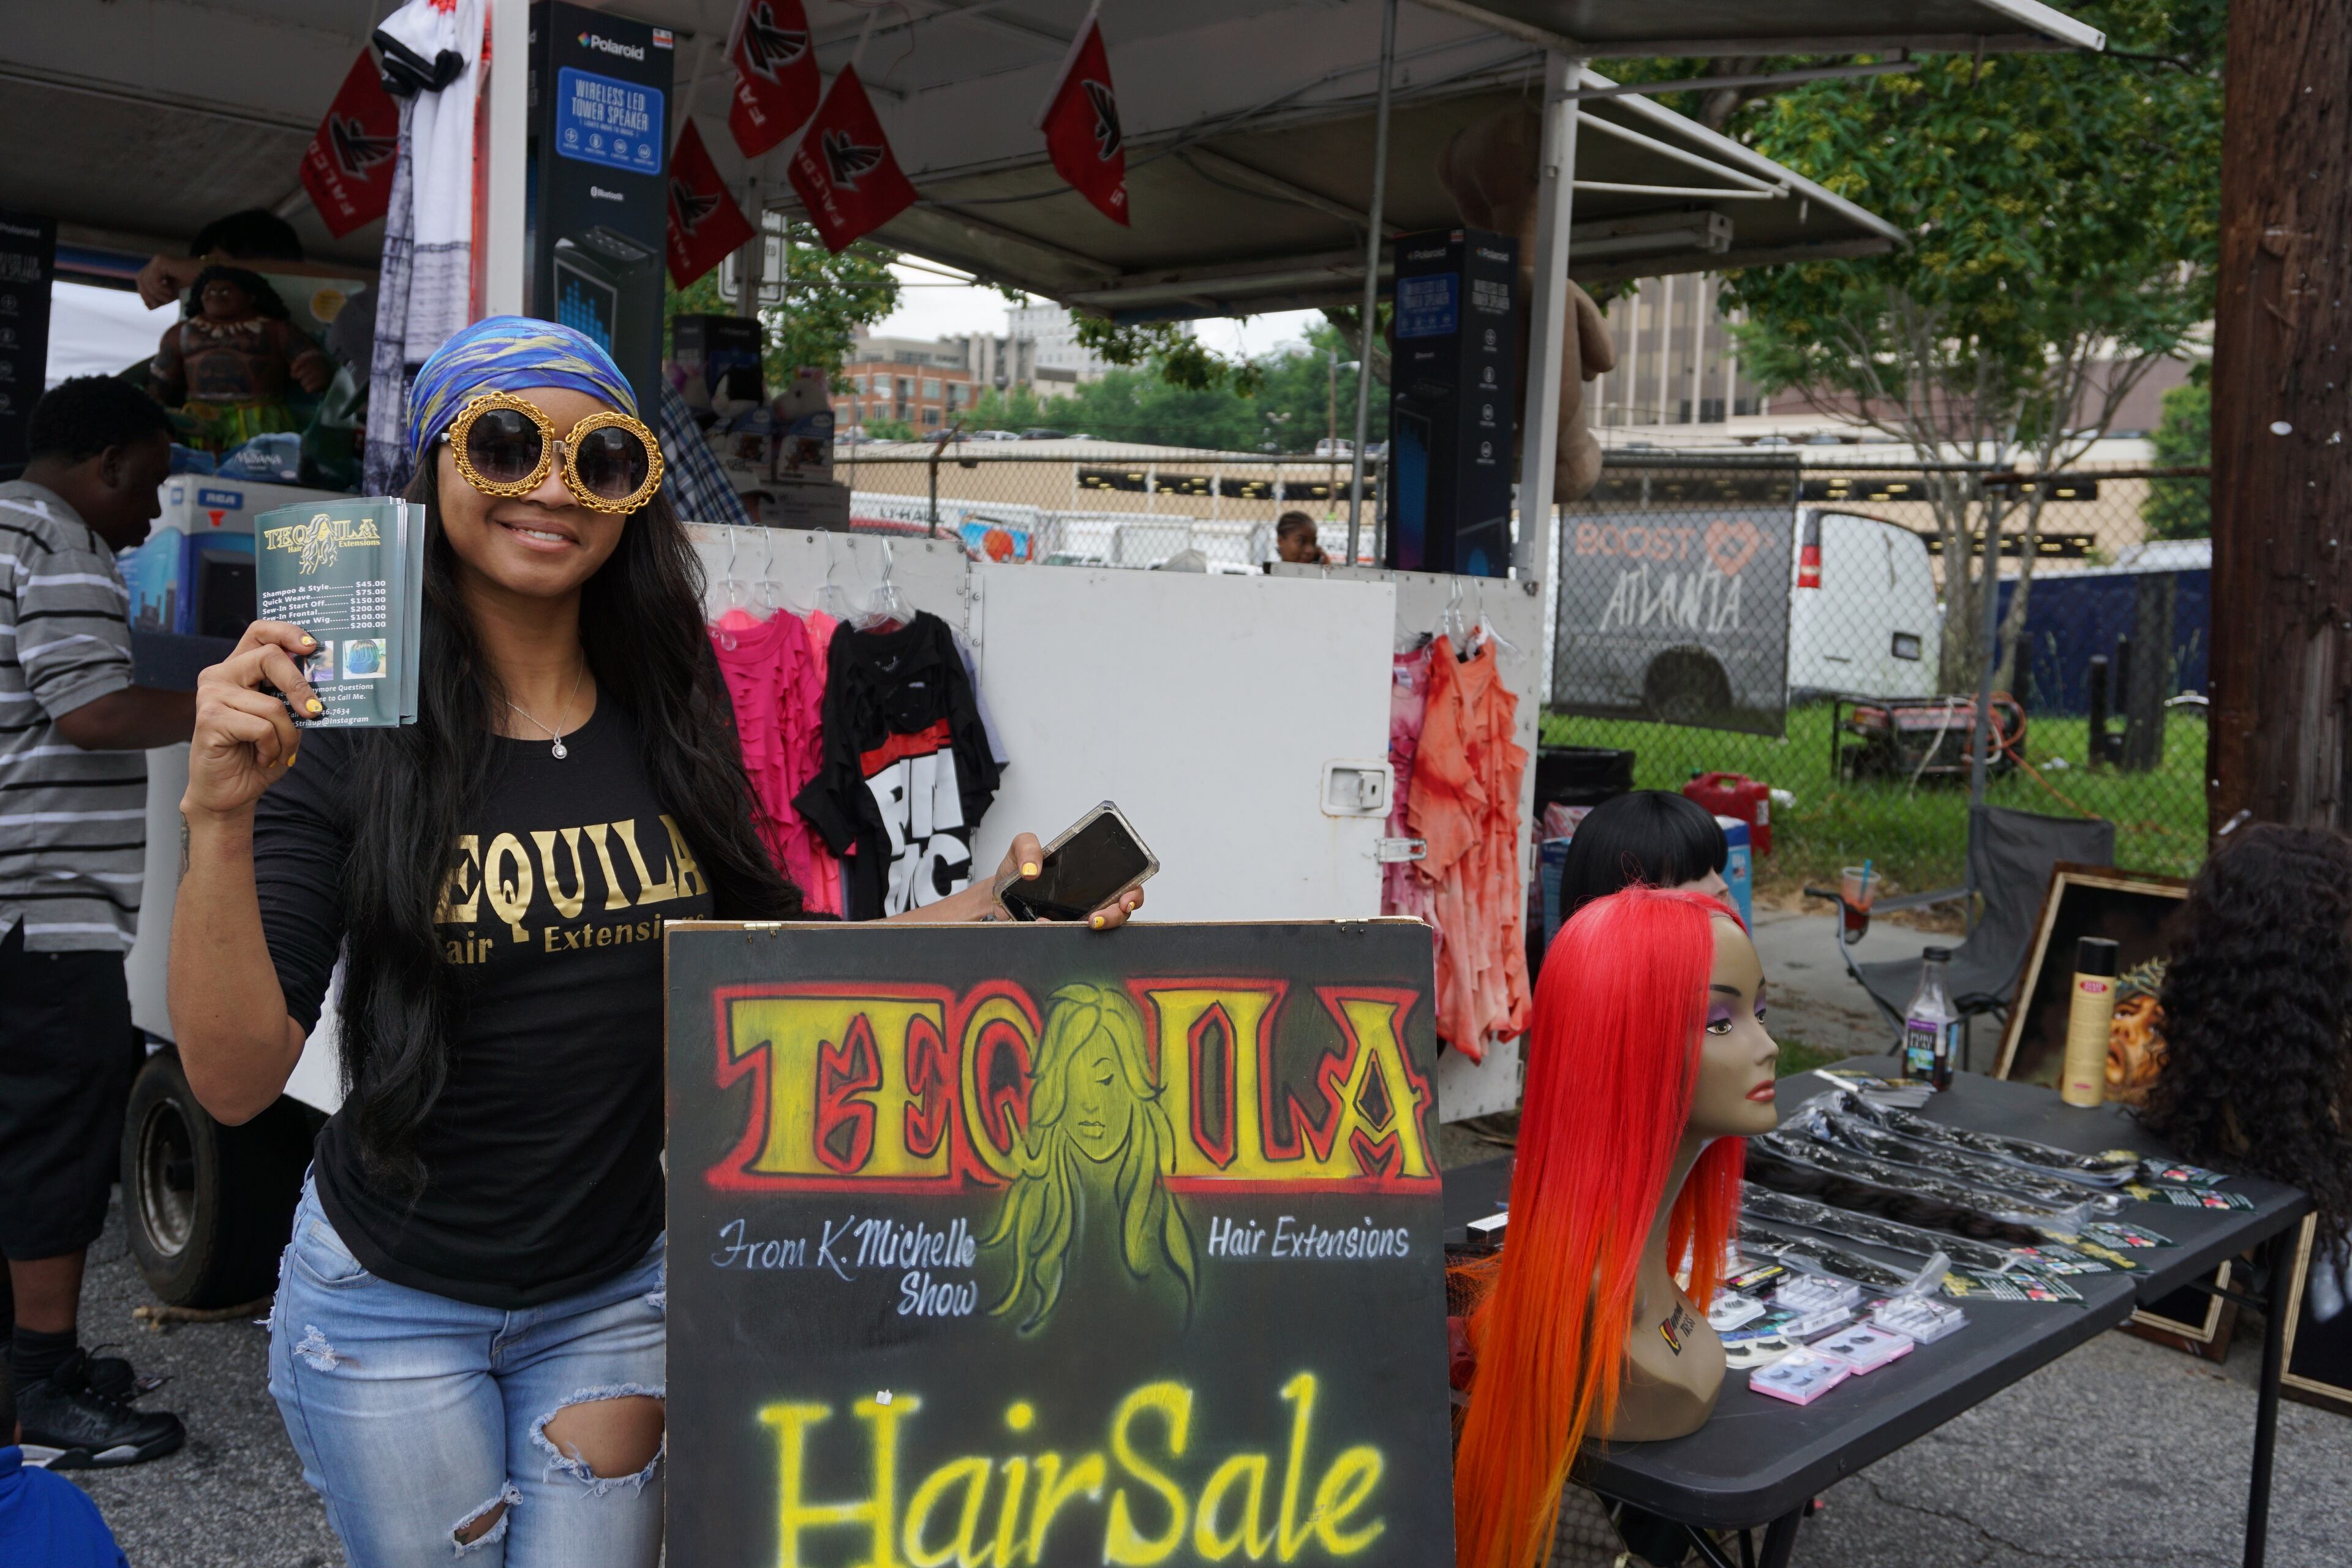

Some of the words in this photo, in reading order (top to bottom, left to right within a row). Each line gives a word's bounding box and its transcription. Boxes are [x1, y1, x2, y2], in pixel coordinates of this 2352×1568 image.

[591, 34, 645, 61] Polaroid
[575, 78, 624, 107] WIRELESS
[627, 91, 646, 112] LED
[571, 97, 605, 122] TOWER
[607, 105, 649, 132] SPEAKER
[287, 545, 303, 554] Hair
[338, 539, 381, 548] Extensions
[1577, 522, 1697, 561] BOOST
[262, 588, 296, 598] Shampoo
[262, 598, 282, 607] Quick
[350, 605, 386, 613] $200.00
[1599, 554, 1741, 635] ATLANTA
[262, 606, 287, 615] Sew-In
[350, 612, 386, 621] $100.00
[338, 684, 374, 692] Questions
[432, 814, 709, 944] EQUILA
[445, 930, 494, 965] air
[543, 913, 704, 954] Extensi
[711, 1218, 807, 1270] From
[1208, 1215, 1267, 1256] Hair
[1271, 1215, 1409, 1258] Extensions
[897, 1271, 979, 1317] Show
